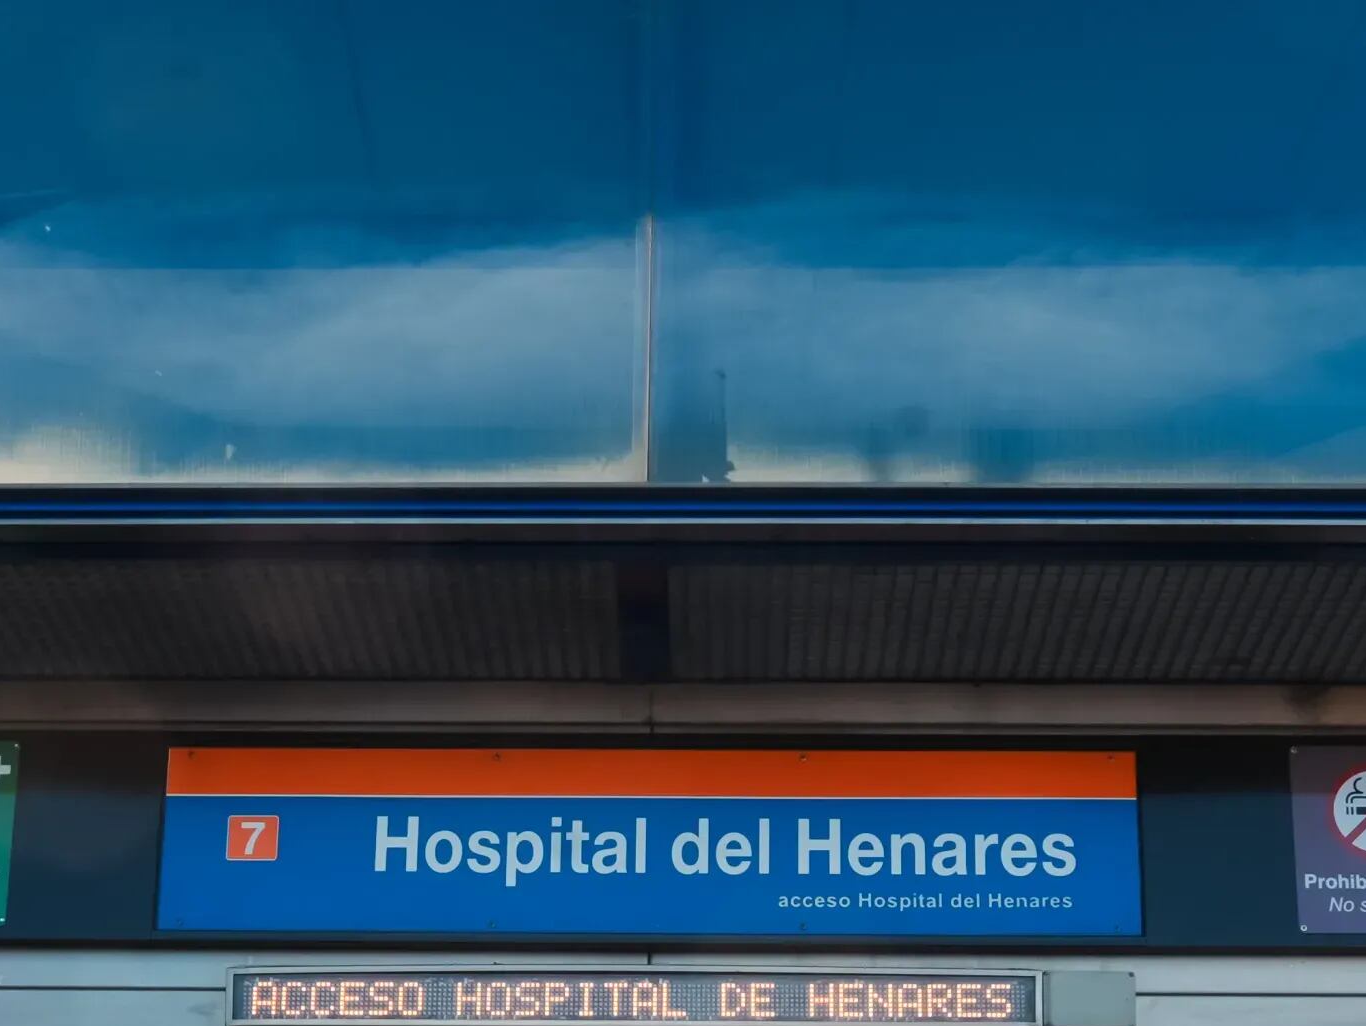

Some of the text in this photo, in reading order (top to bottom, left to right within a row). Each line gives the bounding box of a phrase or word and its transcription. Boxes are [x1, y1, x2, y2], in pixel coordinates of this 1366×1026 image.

[240, 821, 266, 856] 7
[374, 815, 1078, 887] Hospital del Henares
[778, 892, 1074, 912] acceso Hospital del Henares
[1329, 897, 1355, 912] No
[250, 980, 1012, 1019] ACCESO HOSPITAL DE HENARES
